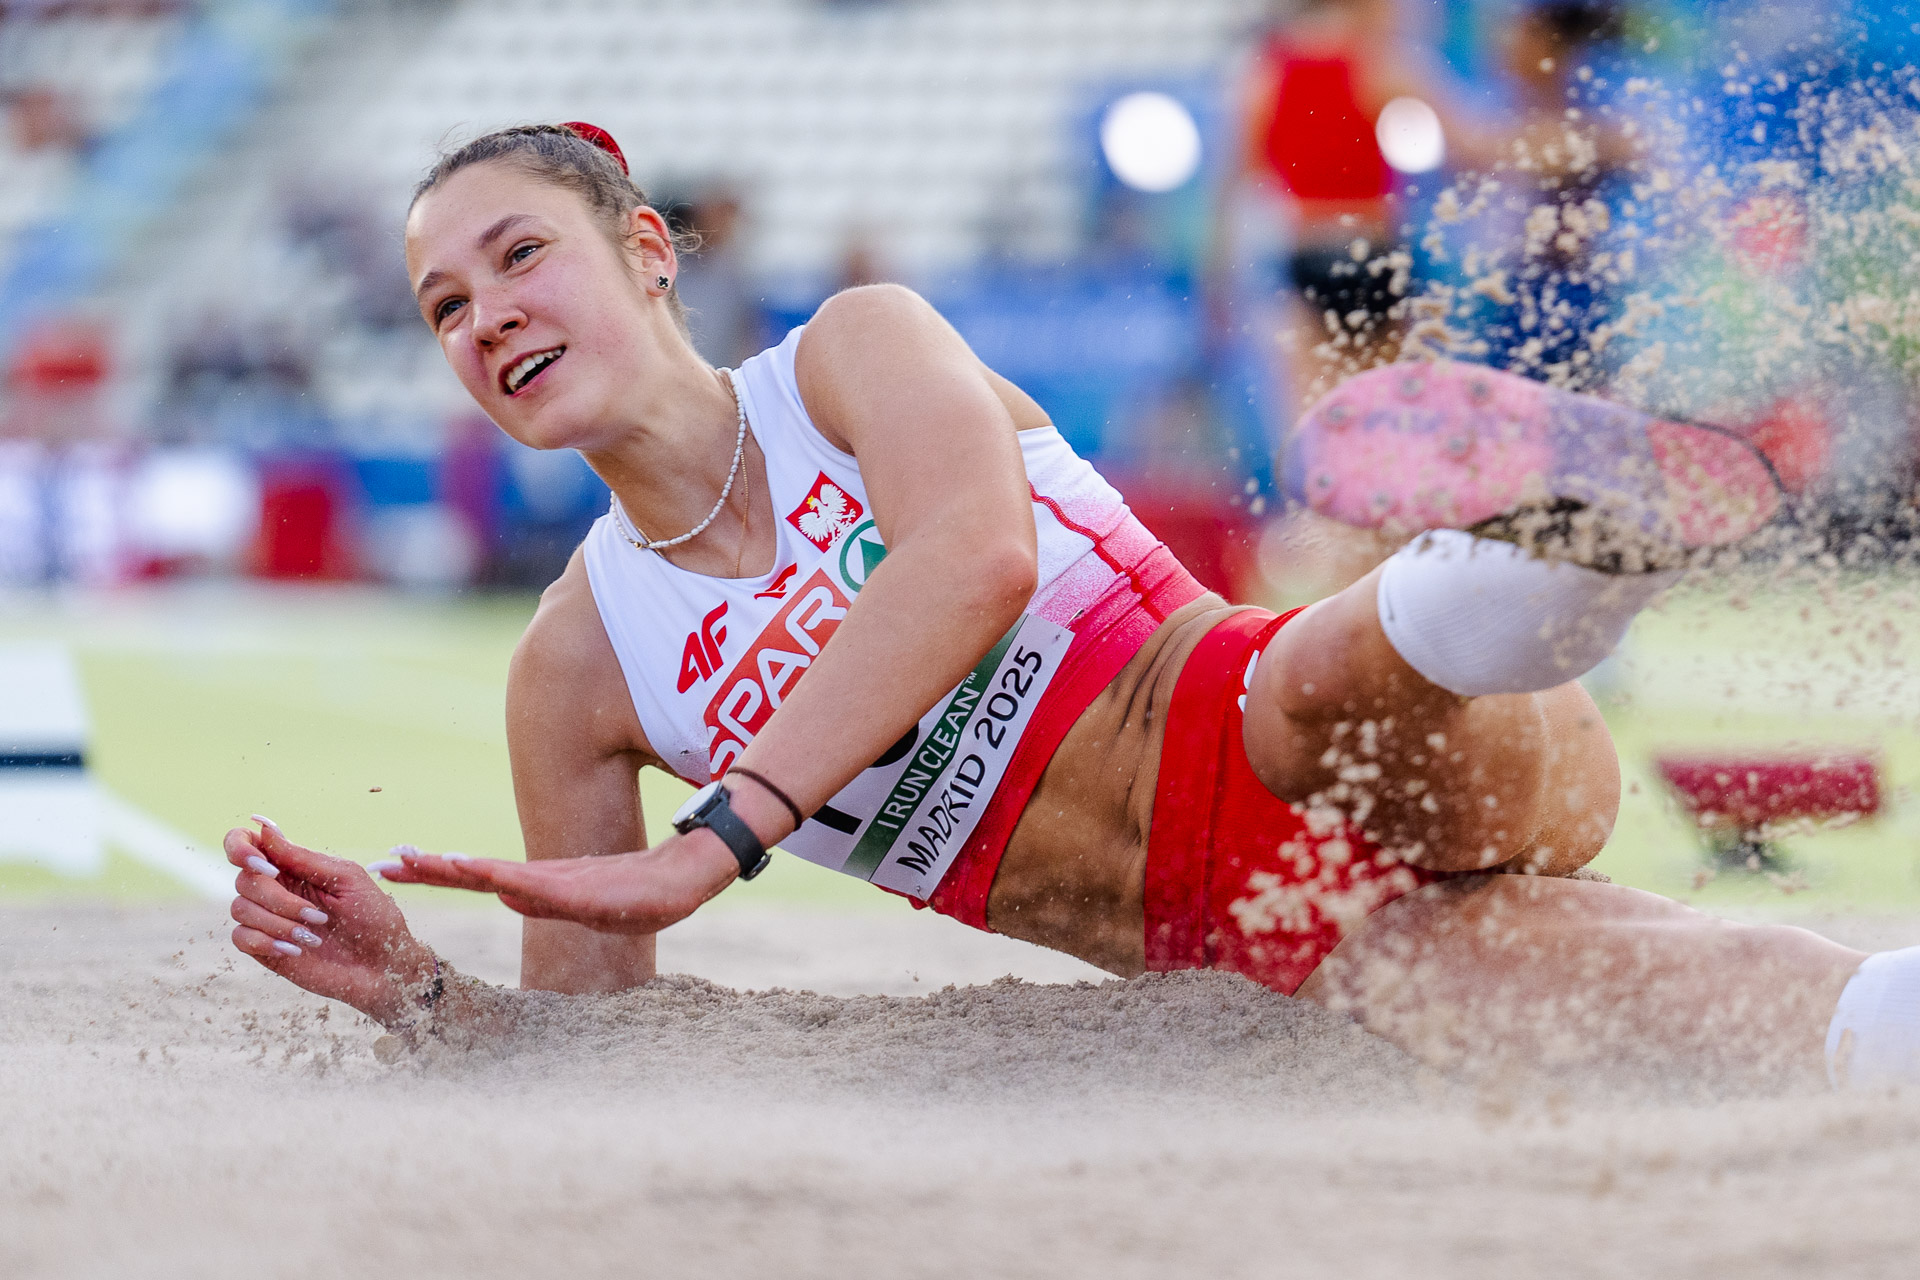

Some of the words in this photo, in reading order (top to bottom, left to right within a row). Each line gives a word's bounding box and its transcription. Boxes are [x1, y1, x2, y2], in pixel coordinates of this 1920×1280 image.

[676, 600, 729, 694] 4F
[883, 768, 933, 819] RUN
[896, 753, 986, 876] MADRID
[974, 645, 1043, 750] 2025
[877, 819, 900, 830] I
